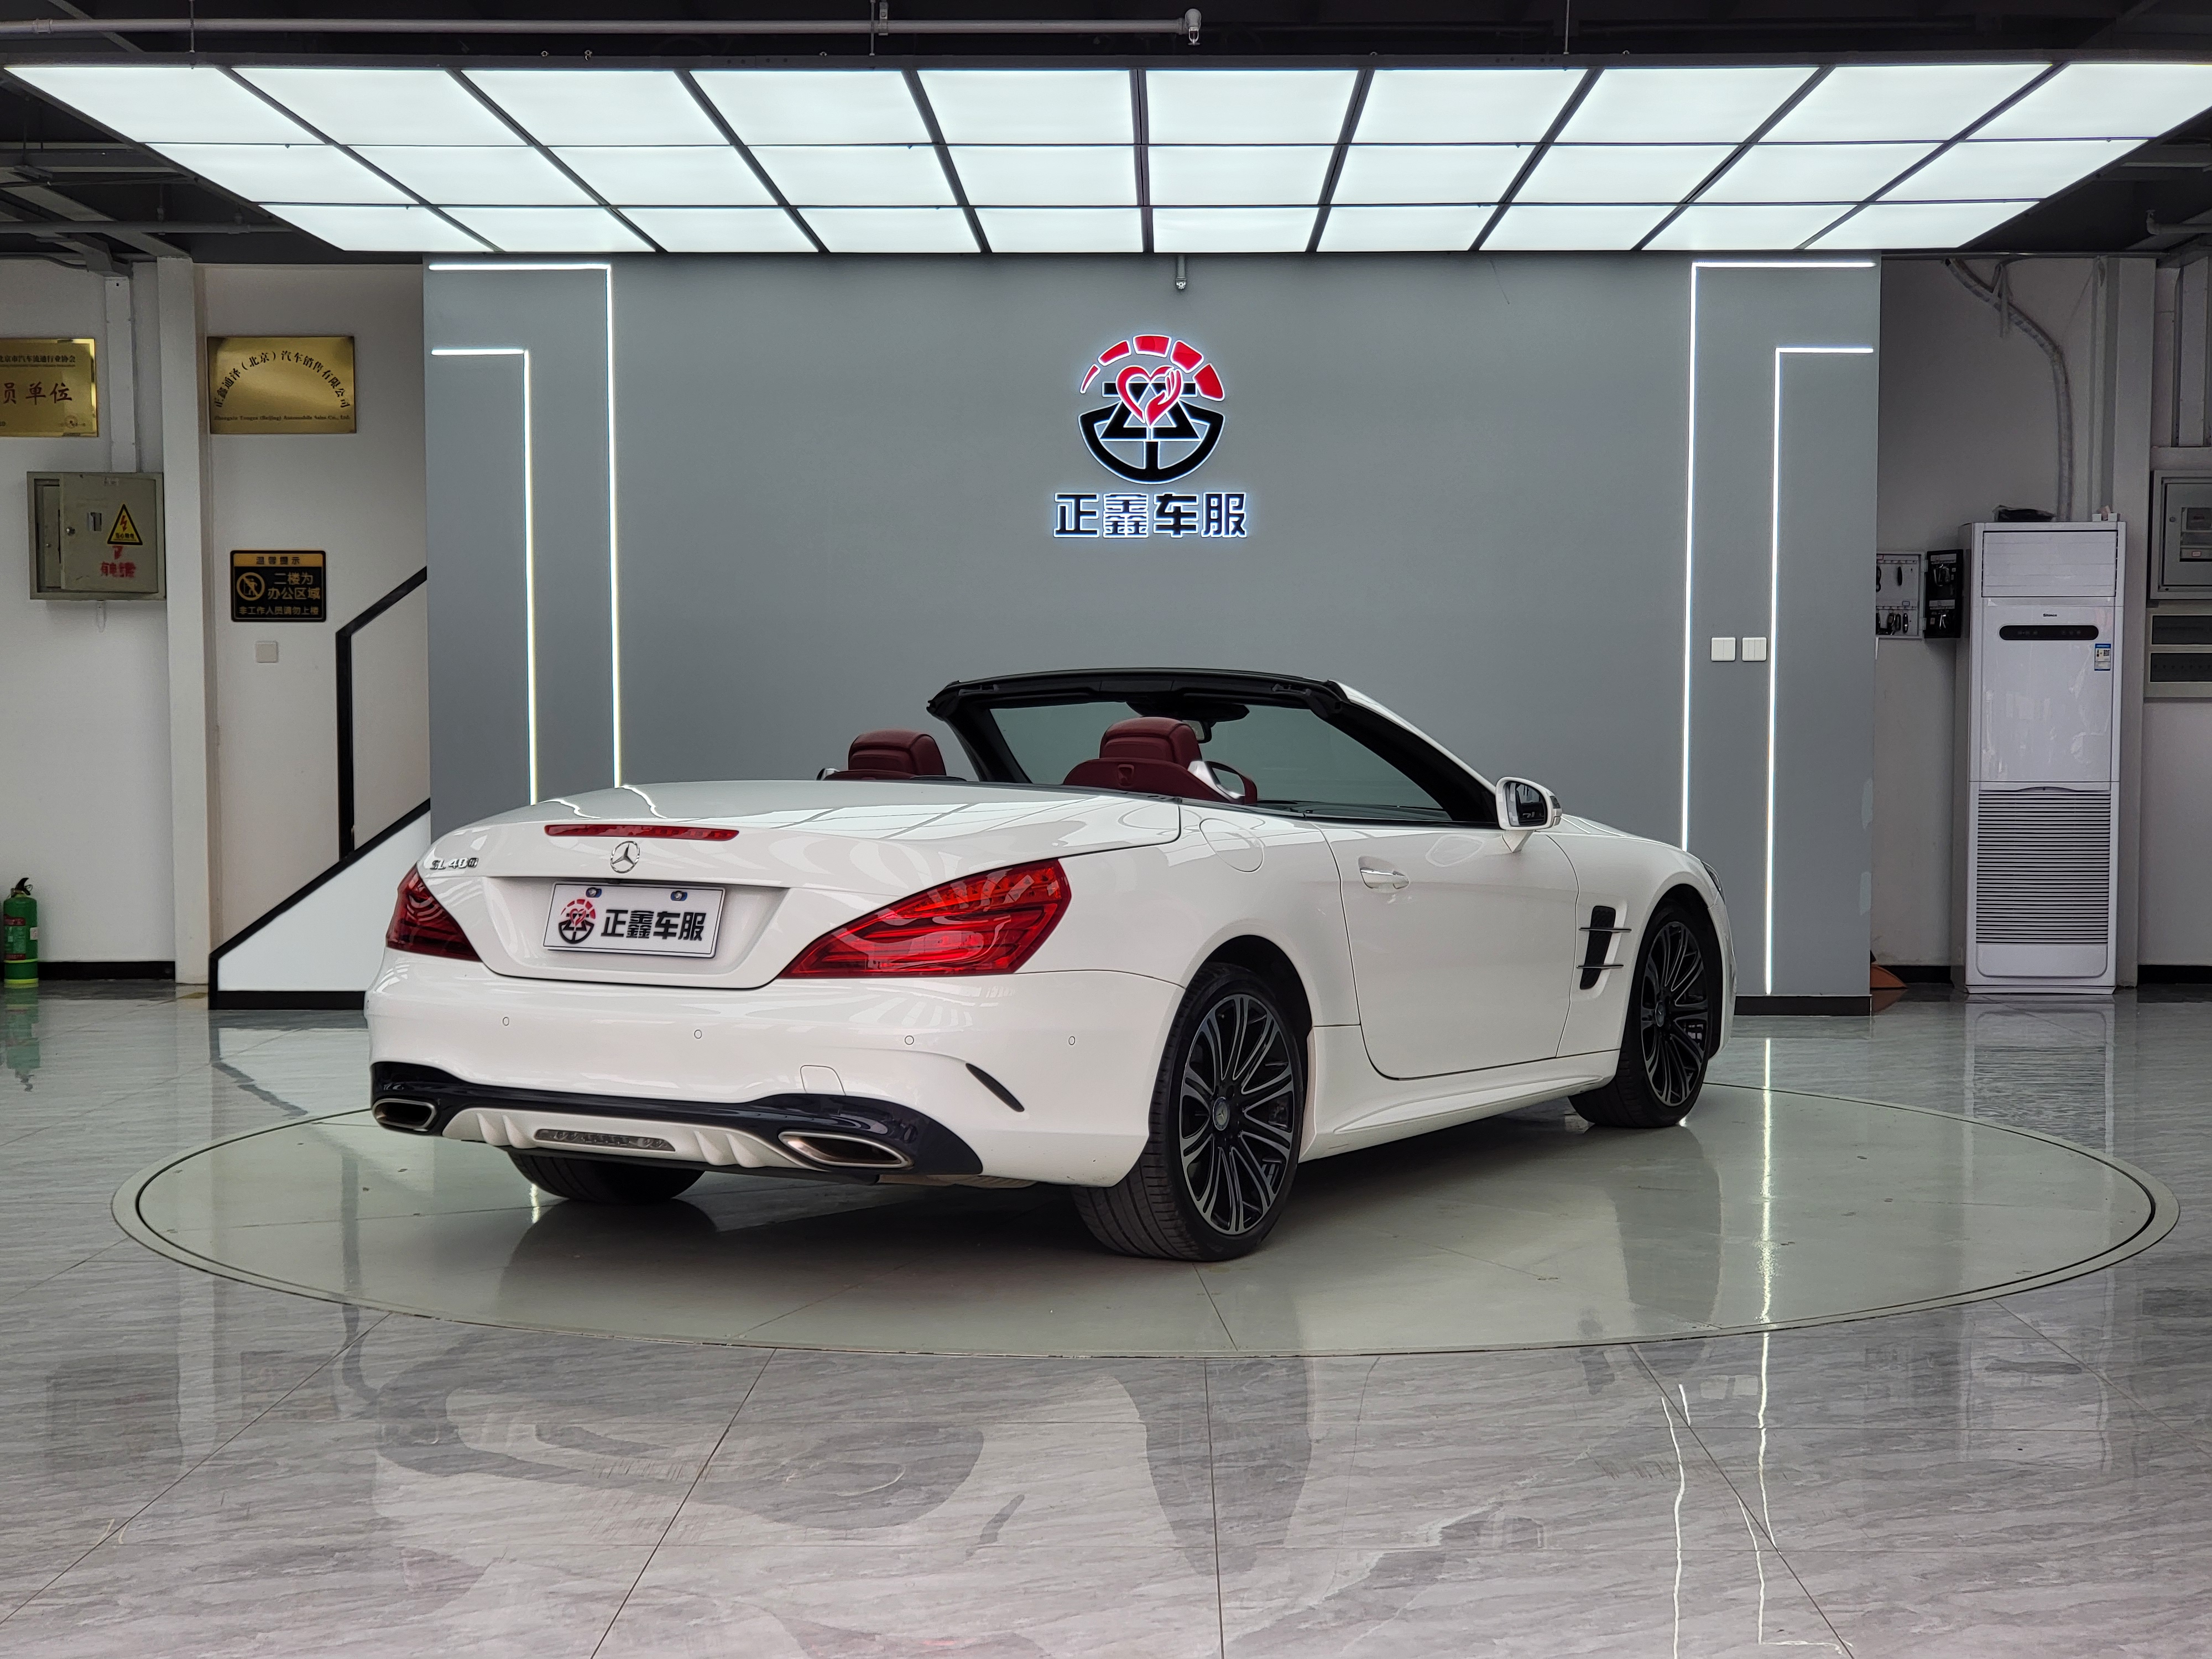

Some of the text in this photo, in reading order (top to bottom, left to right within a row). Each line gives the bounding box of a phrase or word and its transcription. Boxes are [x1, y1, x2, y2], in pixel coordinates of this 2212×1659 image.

[1053, 492, 1248, 538] 正鑫车服
[273, 571, 314, 585] 二楼为
[268, 587, 321, 600] 办公区域
[239, 606, 319, 615] 非工作人员请勿上楼
[430, 857, 479, 870] SL 400
[601, 909, 707, 941] 正鑫车服
